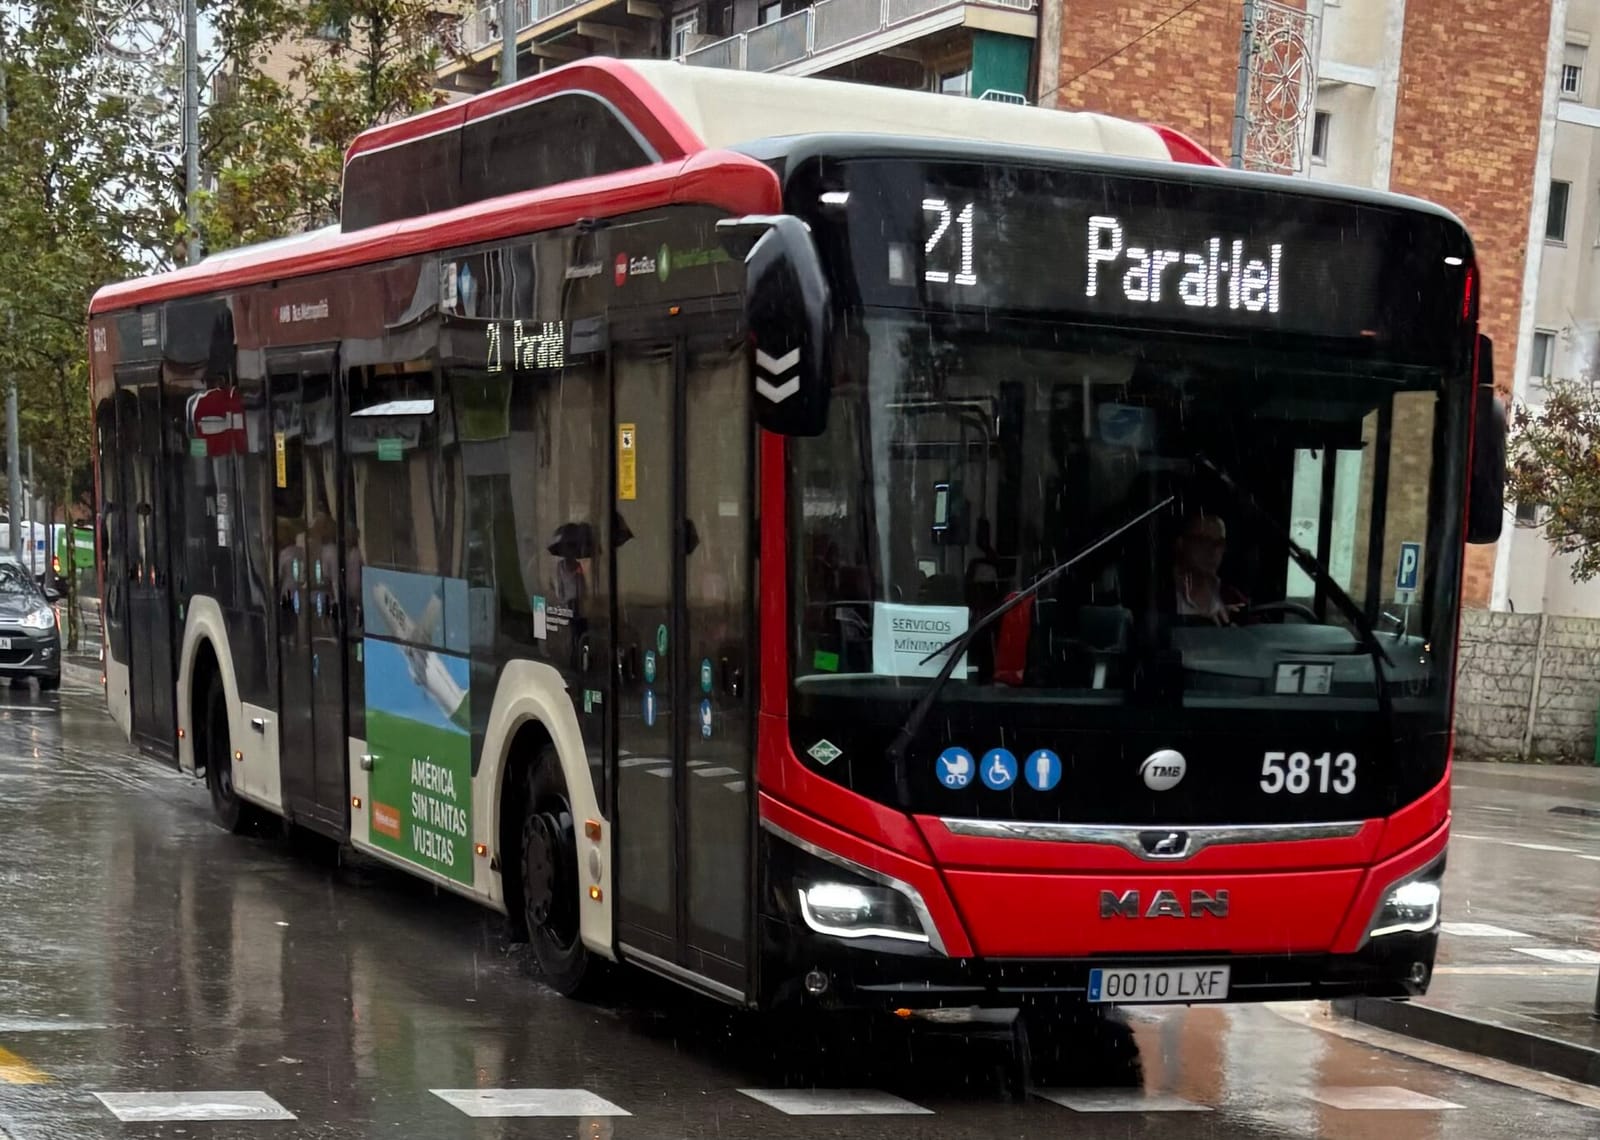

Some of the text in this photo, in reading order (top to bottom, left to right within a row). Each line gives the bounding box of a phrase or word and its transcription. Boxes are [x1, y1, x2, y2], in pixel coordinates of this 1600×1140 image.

[922, 199, 977, 286] 21
[486, 322, 502, 372] 21
[1400, 548, 1417, 584] P
[892, 618, 951, 632] SERVICIOS
[894, 637, 951, 652] MÍNIMO
[411, 755, 457, 802] AMÉRICA,
[1152, 765, 1181, 777] TMB
[1259, 751, 1357, 794] 5813
[411, 791, 428, 822] SIN
[428, 796, 467, 837] TANTAS
[1099, 889, 1230, 919] MAN
[1106, 970, 1224, 997] 0010 LXF
